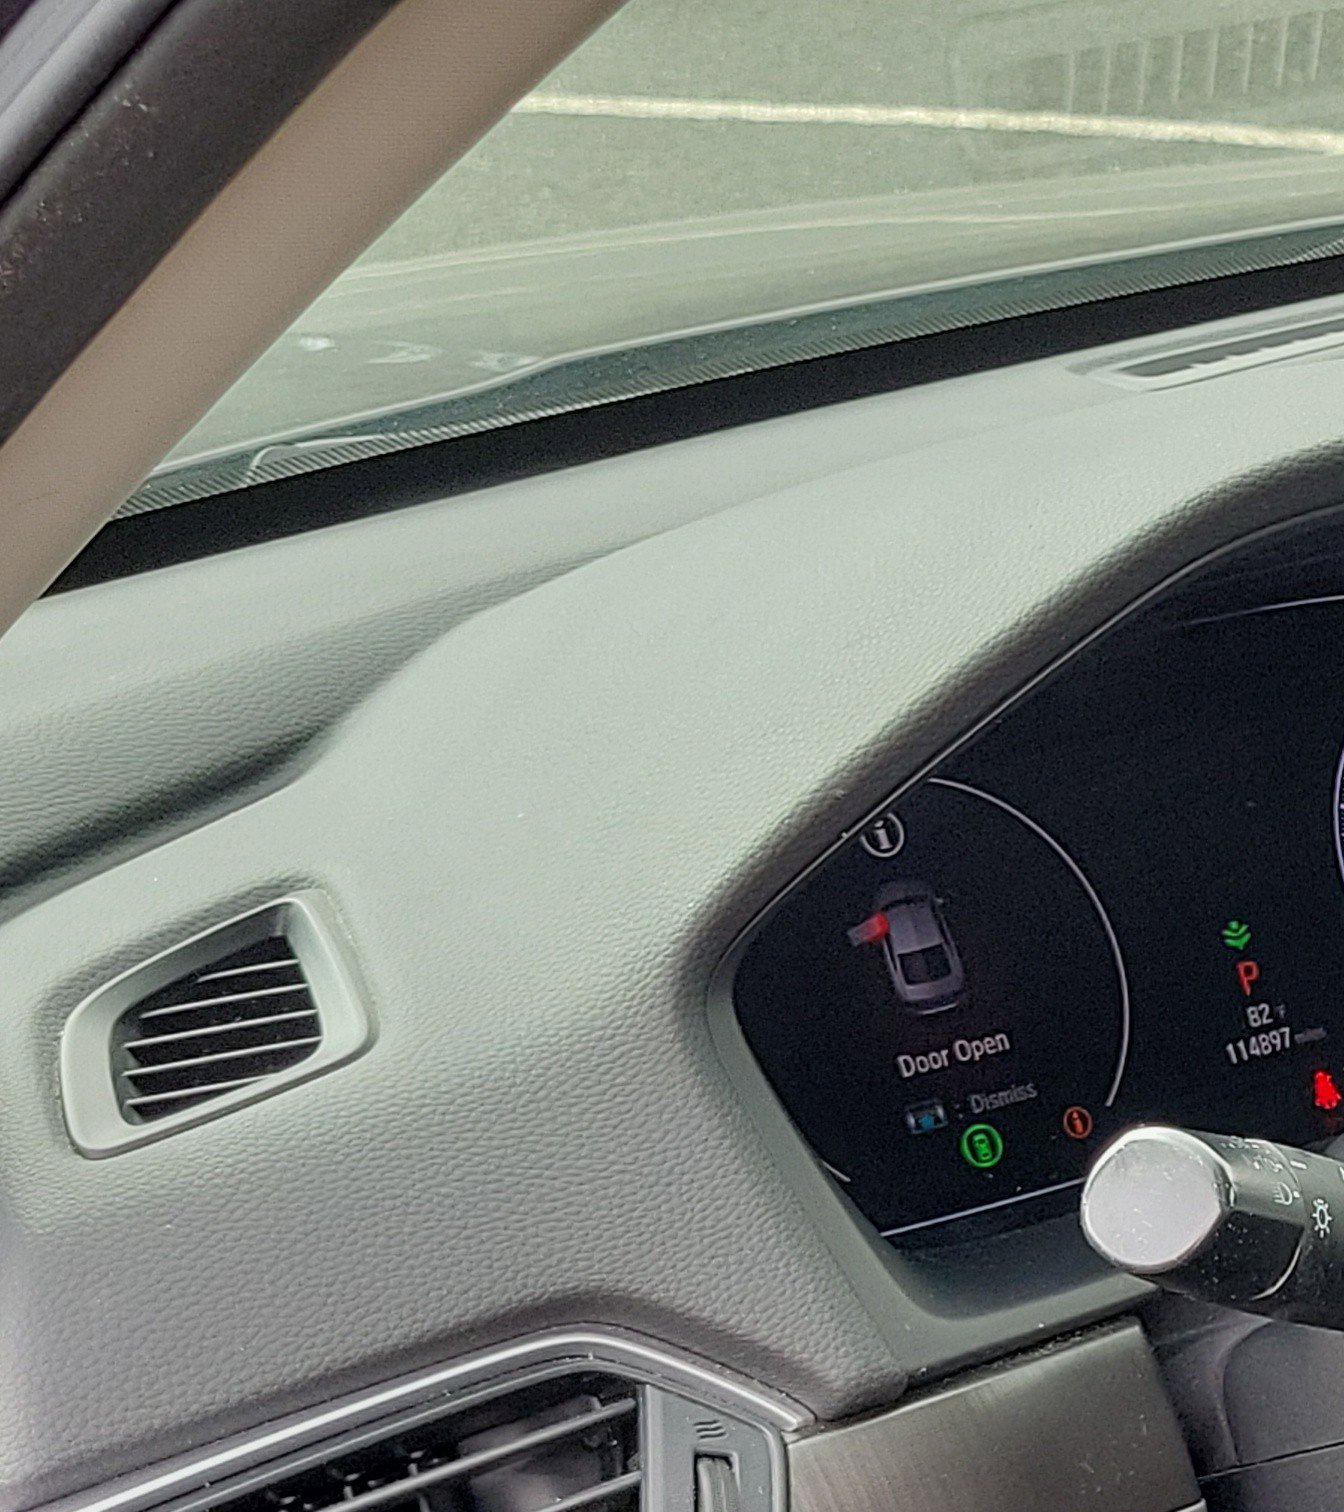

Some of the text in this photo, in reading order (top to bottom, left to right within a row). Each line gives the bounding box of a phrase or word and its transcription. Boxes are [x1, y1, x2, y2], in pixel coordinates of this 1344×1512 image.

[1236, 961, 1259, 996] P
[1246, 1003, 1274, 1028] 82
[897, 1032, 1011, 1078] Door Open
[1225, 1027, 1291, 1065] 114897
[969, 1082, 1038, 1115] Dismiss
